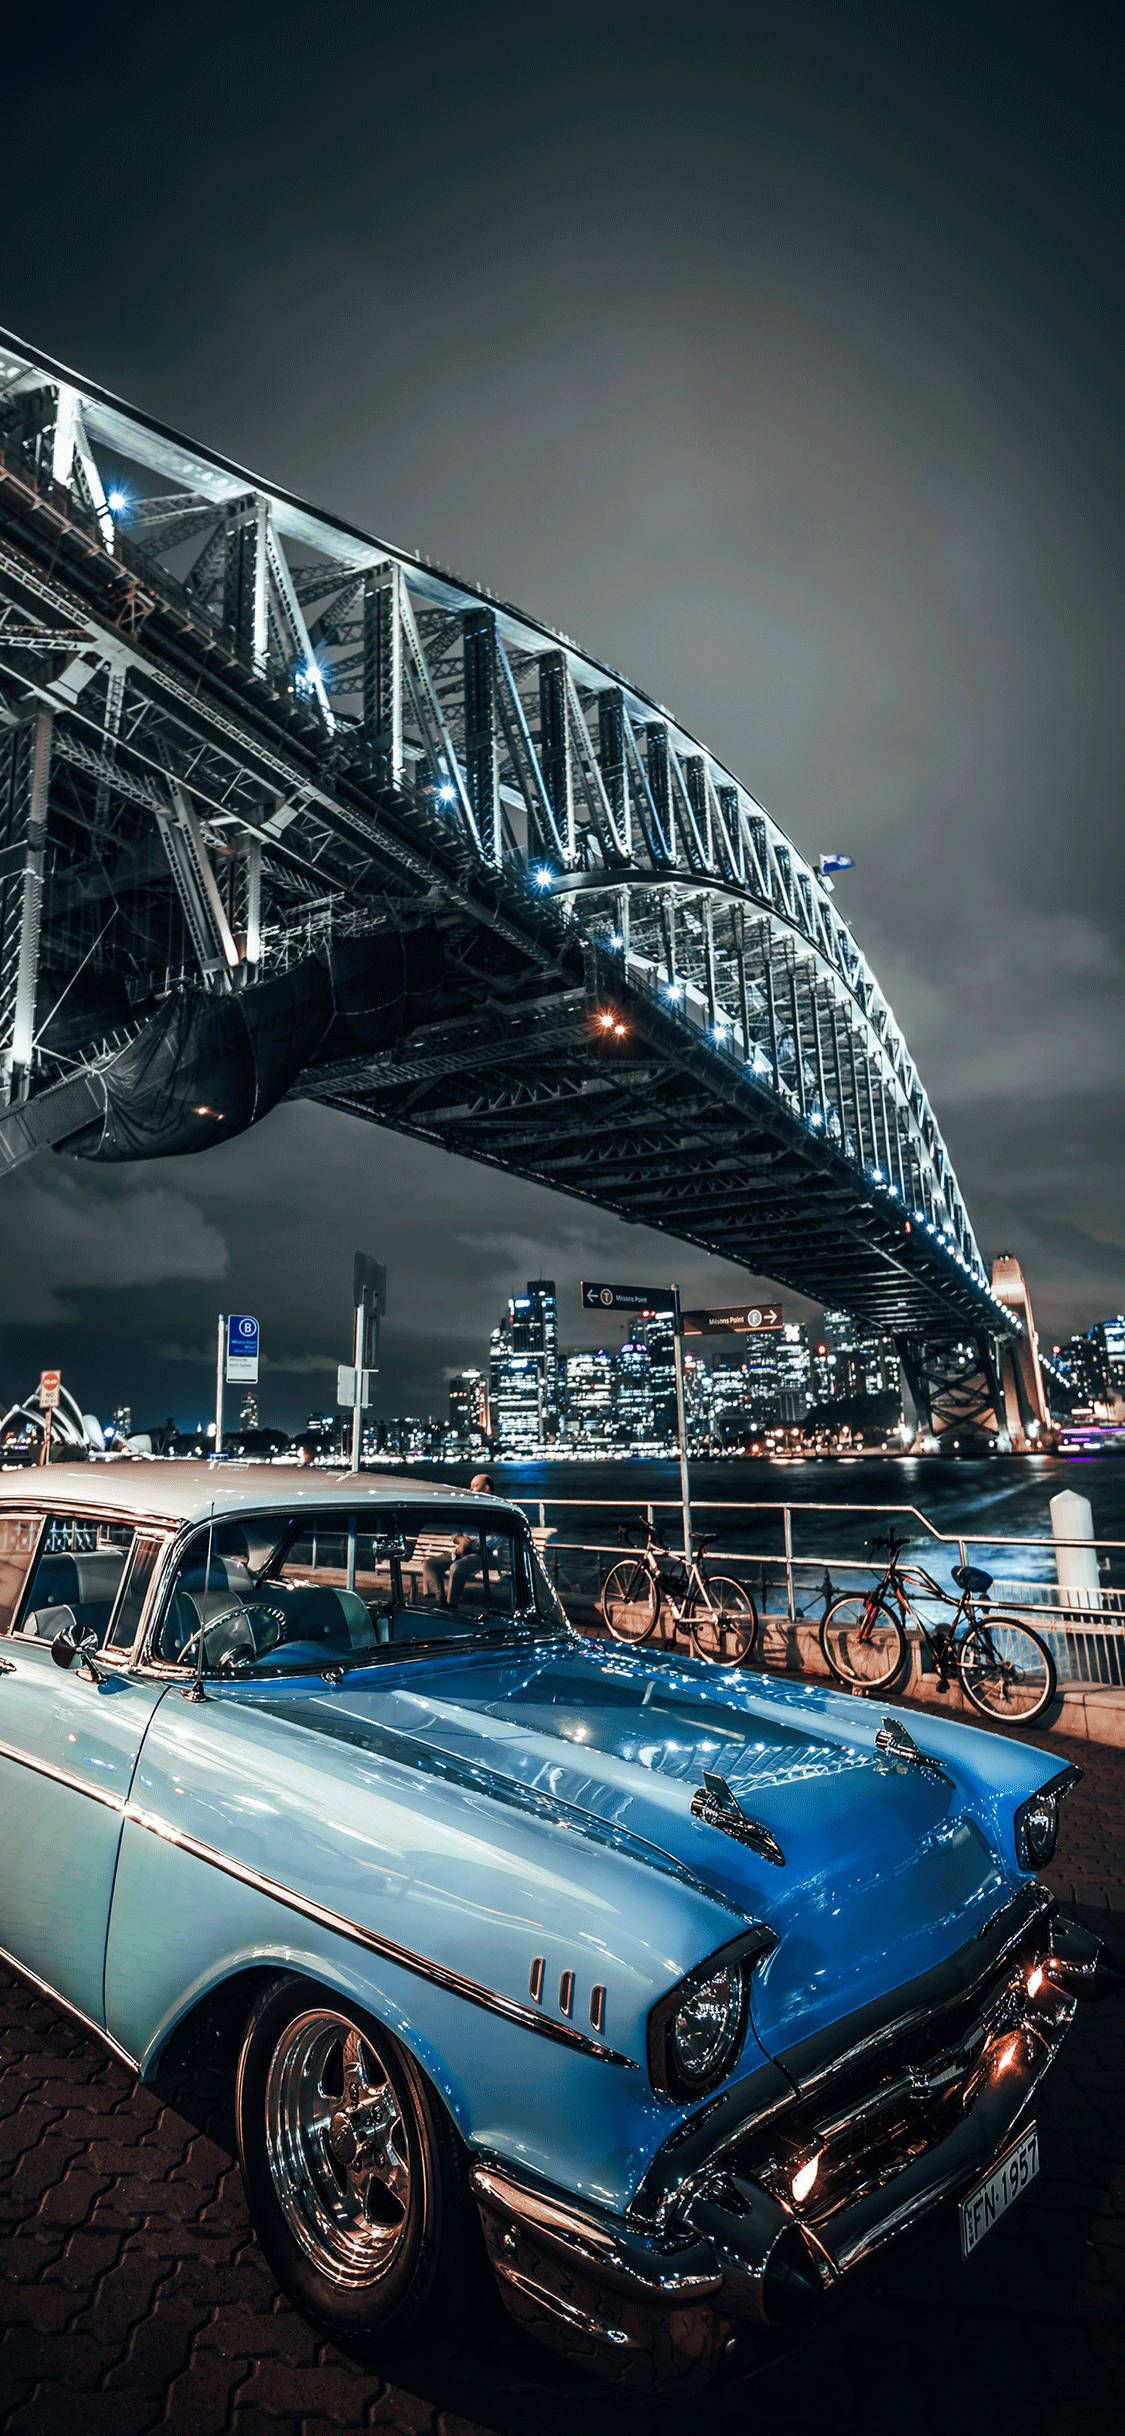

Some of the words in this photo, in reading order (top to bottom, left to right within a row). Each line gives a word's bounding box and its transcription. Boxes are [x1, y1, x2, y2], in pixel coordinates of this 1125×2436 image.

[615, 1294, 634, 1303] Milsons
[709, 1318, 729, 1326] Milsons
[730, 1316, 744, 1324] Point
